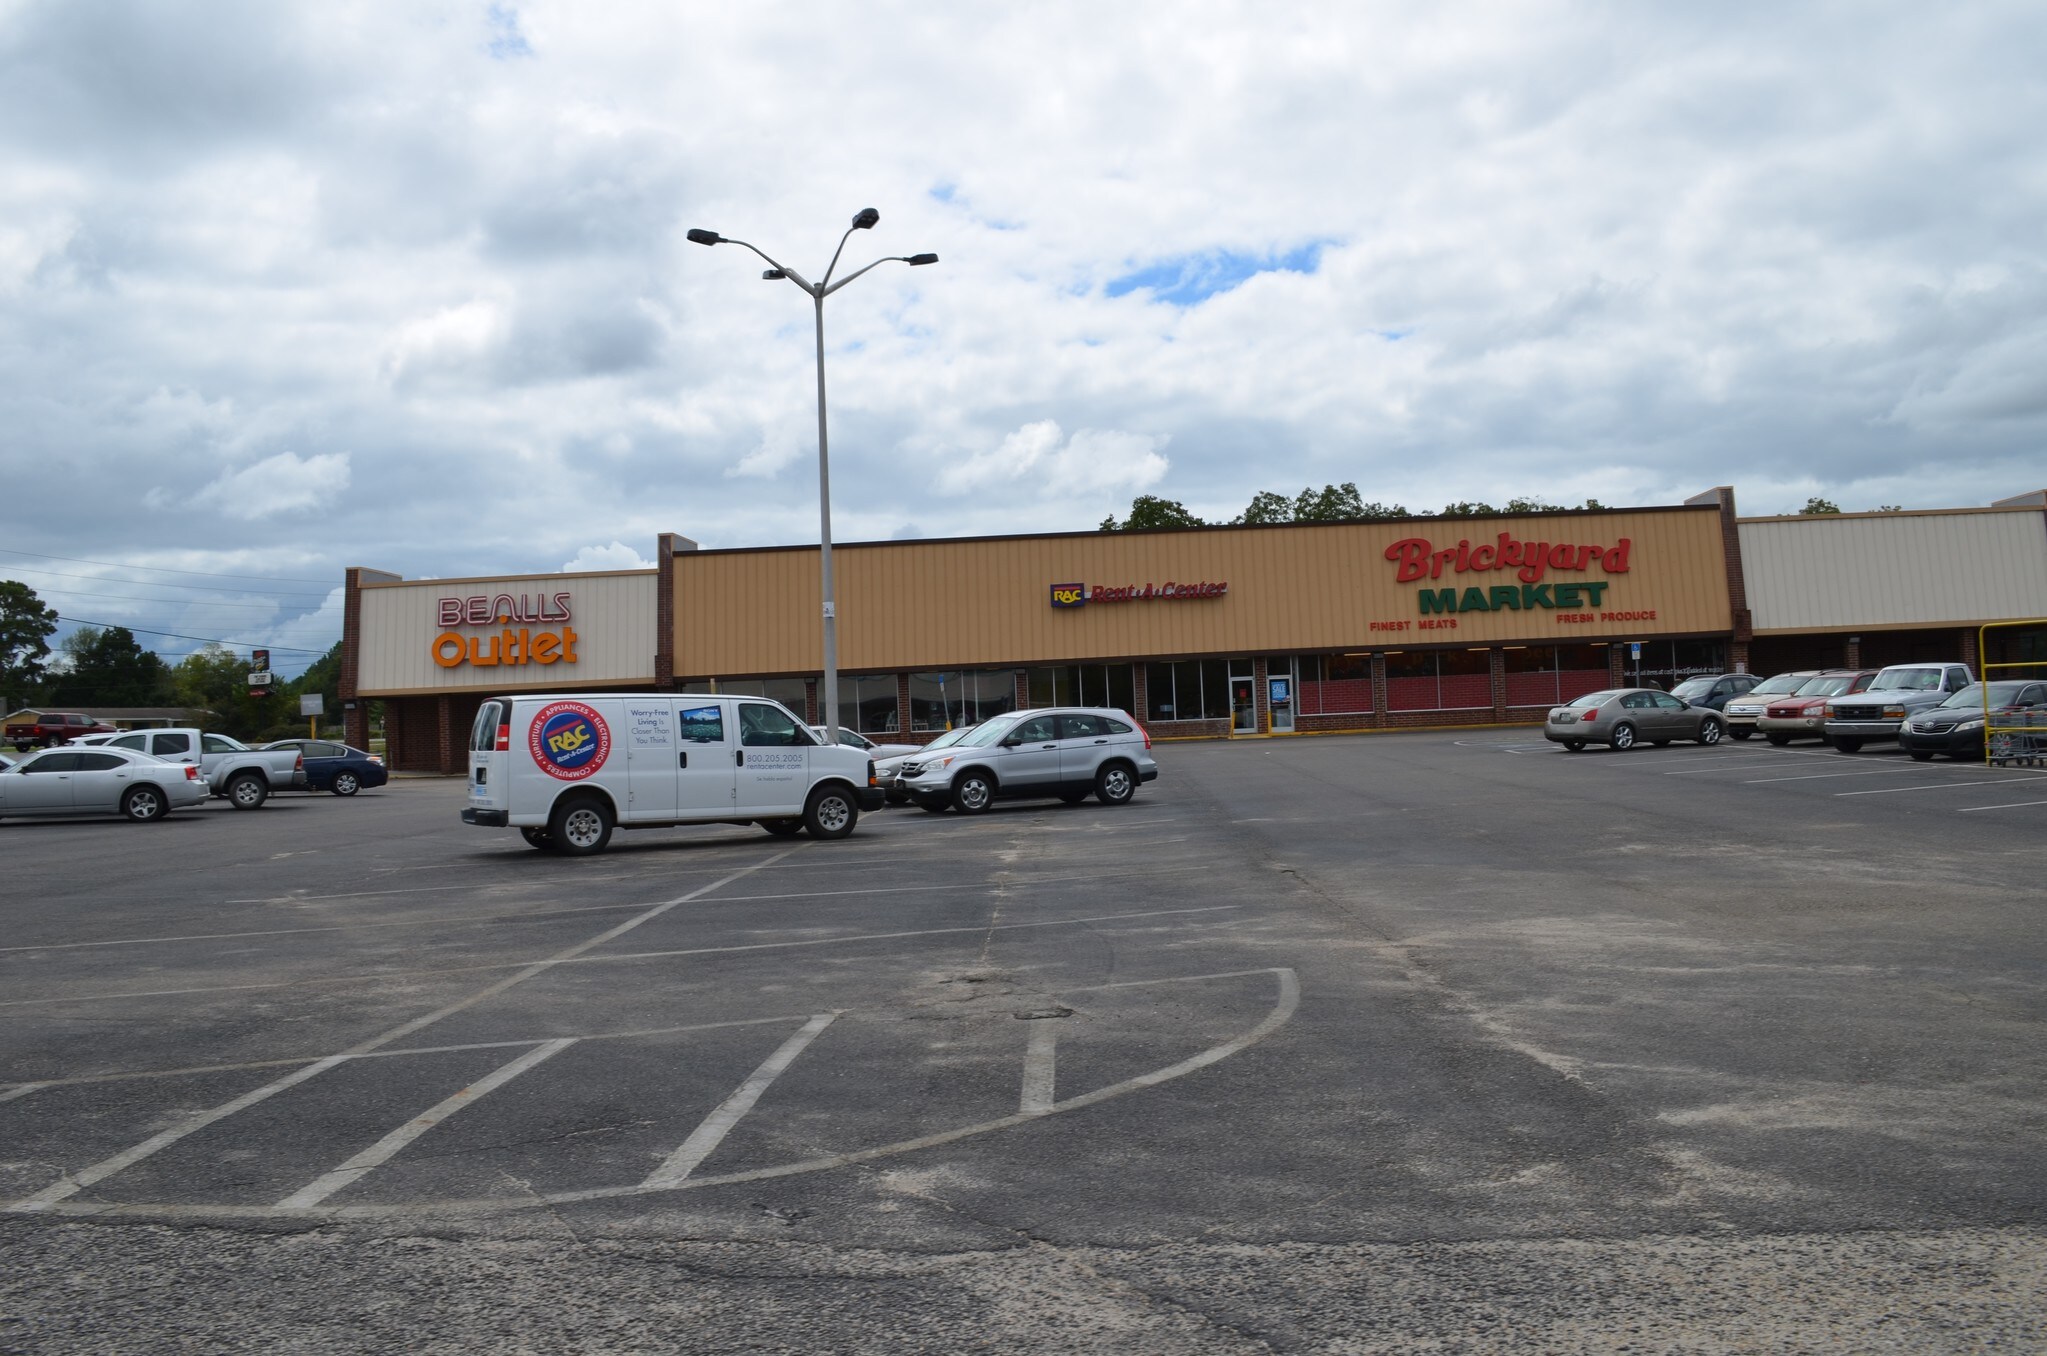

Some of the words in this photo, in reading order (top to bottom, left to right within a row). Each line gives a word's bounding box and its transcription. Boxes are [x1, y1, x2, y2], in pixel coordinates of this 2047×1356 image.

[1384, 532, 1631, 583] Brickyard
[1053, 590, 1082, 604] RAC
[1418, 581, 1609, 614] MARKET
[437, 592, 571, 627] BEALLS
[1556, 613, 1594, 624] FRESH
[1601, 610, 1657, 622] PRODUCE
[1369, 620, 1411, 631] FINEST
[1418, 618, 1458, 630] MEATS
[431, 626, 577, 668] Outlet
[545, 704, 589, 716] APPLIANCES
[630, 709, 669, 717] Worry-Free
[637, 718, 657, 726] Living
[631, 727, 652, 735] Closer
[532, 720, 544, 760] FURNITURE
[548, 724, 590, 753] RAC
[593, 717, 608, 763] ELECTRONICS
[546, 764, 591, 778] COMPUTERS
